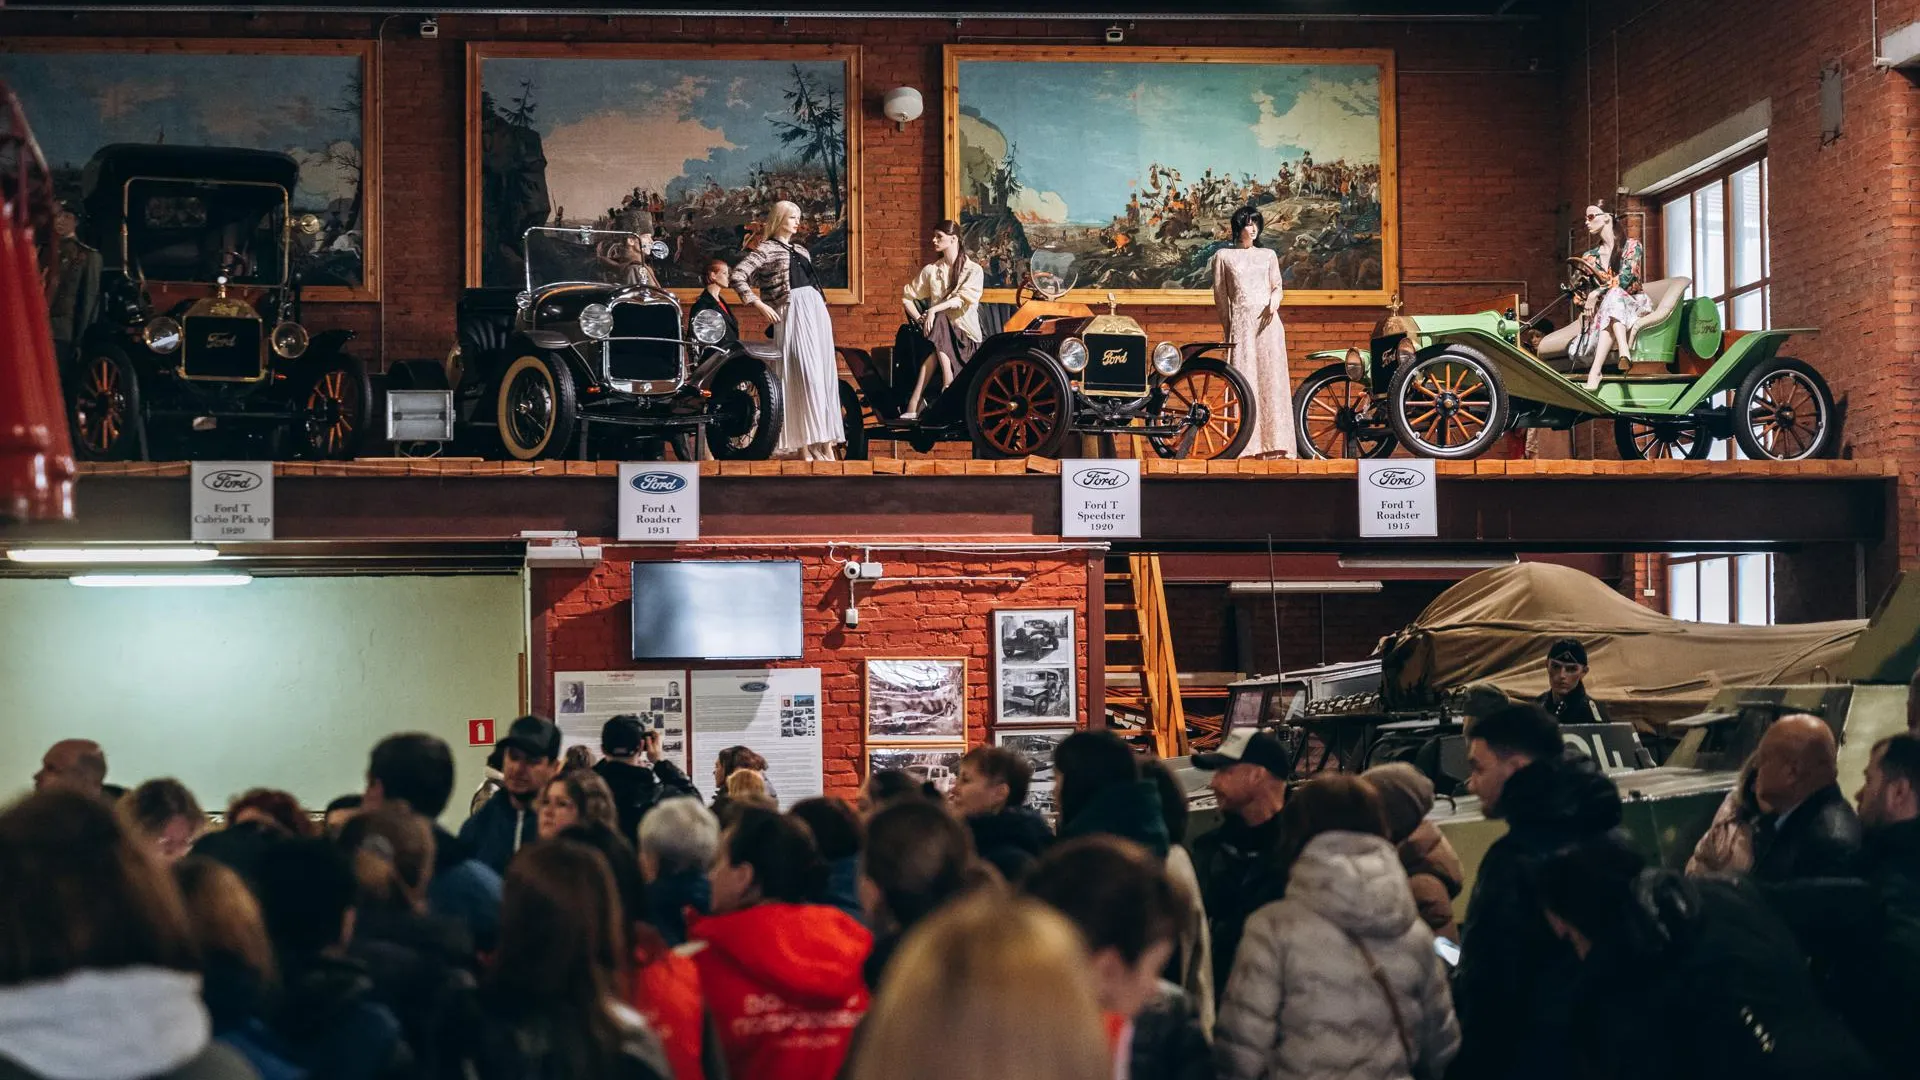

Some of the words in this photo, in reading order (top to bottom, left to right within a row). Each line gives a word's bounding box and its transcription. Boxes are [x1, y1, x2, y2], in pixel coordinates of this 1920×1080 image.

[206, 331, 237, 349] Ford
[1102, 348, 1129, 366] Ford
[212, 472, 253, 488] Ford
[640, 474, 678, 490] Ford
[1082, 470, 1120, 486] Ford
[1379, 470, 1416, 486] Ford
[214, 503, 239, 513] Ford
[241, 503, 251, 513] T
[641, 504, 665, 513] Ford
[668, 504, 676, 513] A
[1084, 500, 1107, 510] Ford
[1109, 500, 1119, 510] T
[1381, 500, 1404, 509] Ford
[1406, 500, 1415, 509] T
[194, 514, 229, 524] Cabrio
[231, 514, 255, 524] Pick
[257, 516, 271, 526] up
[636, 514, 682, 524] Roadster
[1077, 511, 1126, 522] Speedster
[1376, 510, 1421, 520] Roadster
[647, 526, 671, 534] 1931
[1090, 523, 1114, 531] 1920
[1387, 522, 1410, 530] 1915
